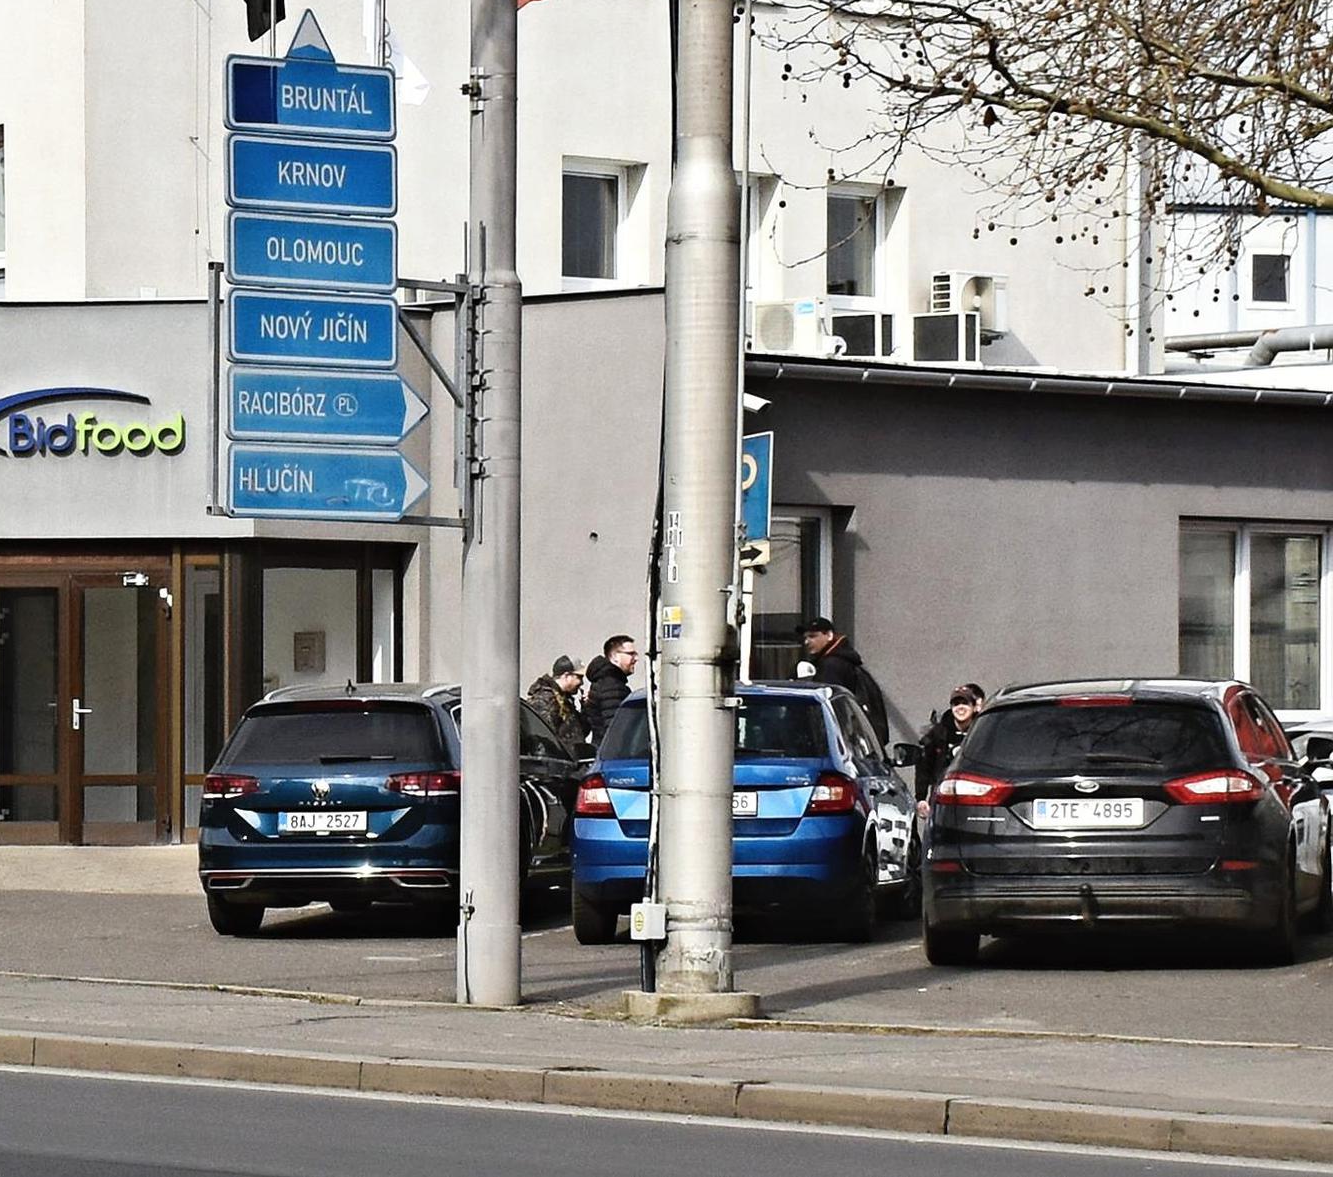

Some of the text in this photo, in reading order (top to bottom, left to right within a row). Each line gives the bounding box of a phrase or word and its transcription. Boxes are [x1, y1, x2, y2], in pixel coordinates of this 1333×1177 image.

[282, 84, 372, 114] BRUNTÁL
[278, 161, 346, 188] KRNOV
[266, 237, 364, 266] OLOMOUC
[260, 310, 367, 344] NOVÝ JIČÍN
[238, 387, 353, 417] RACIBÓRZ PL
[8, 411, 184, 454] Bidfood
[239, 464, 313, 493] HLUČÍN
[291, 814, 359, 828] 8AJ 2527
[1051, 803, 1132, 818] 2TE 4895
